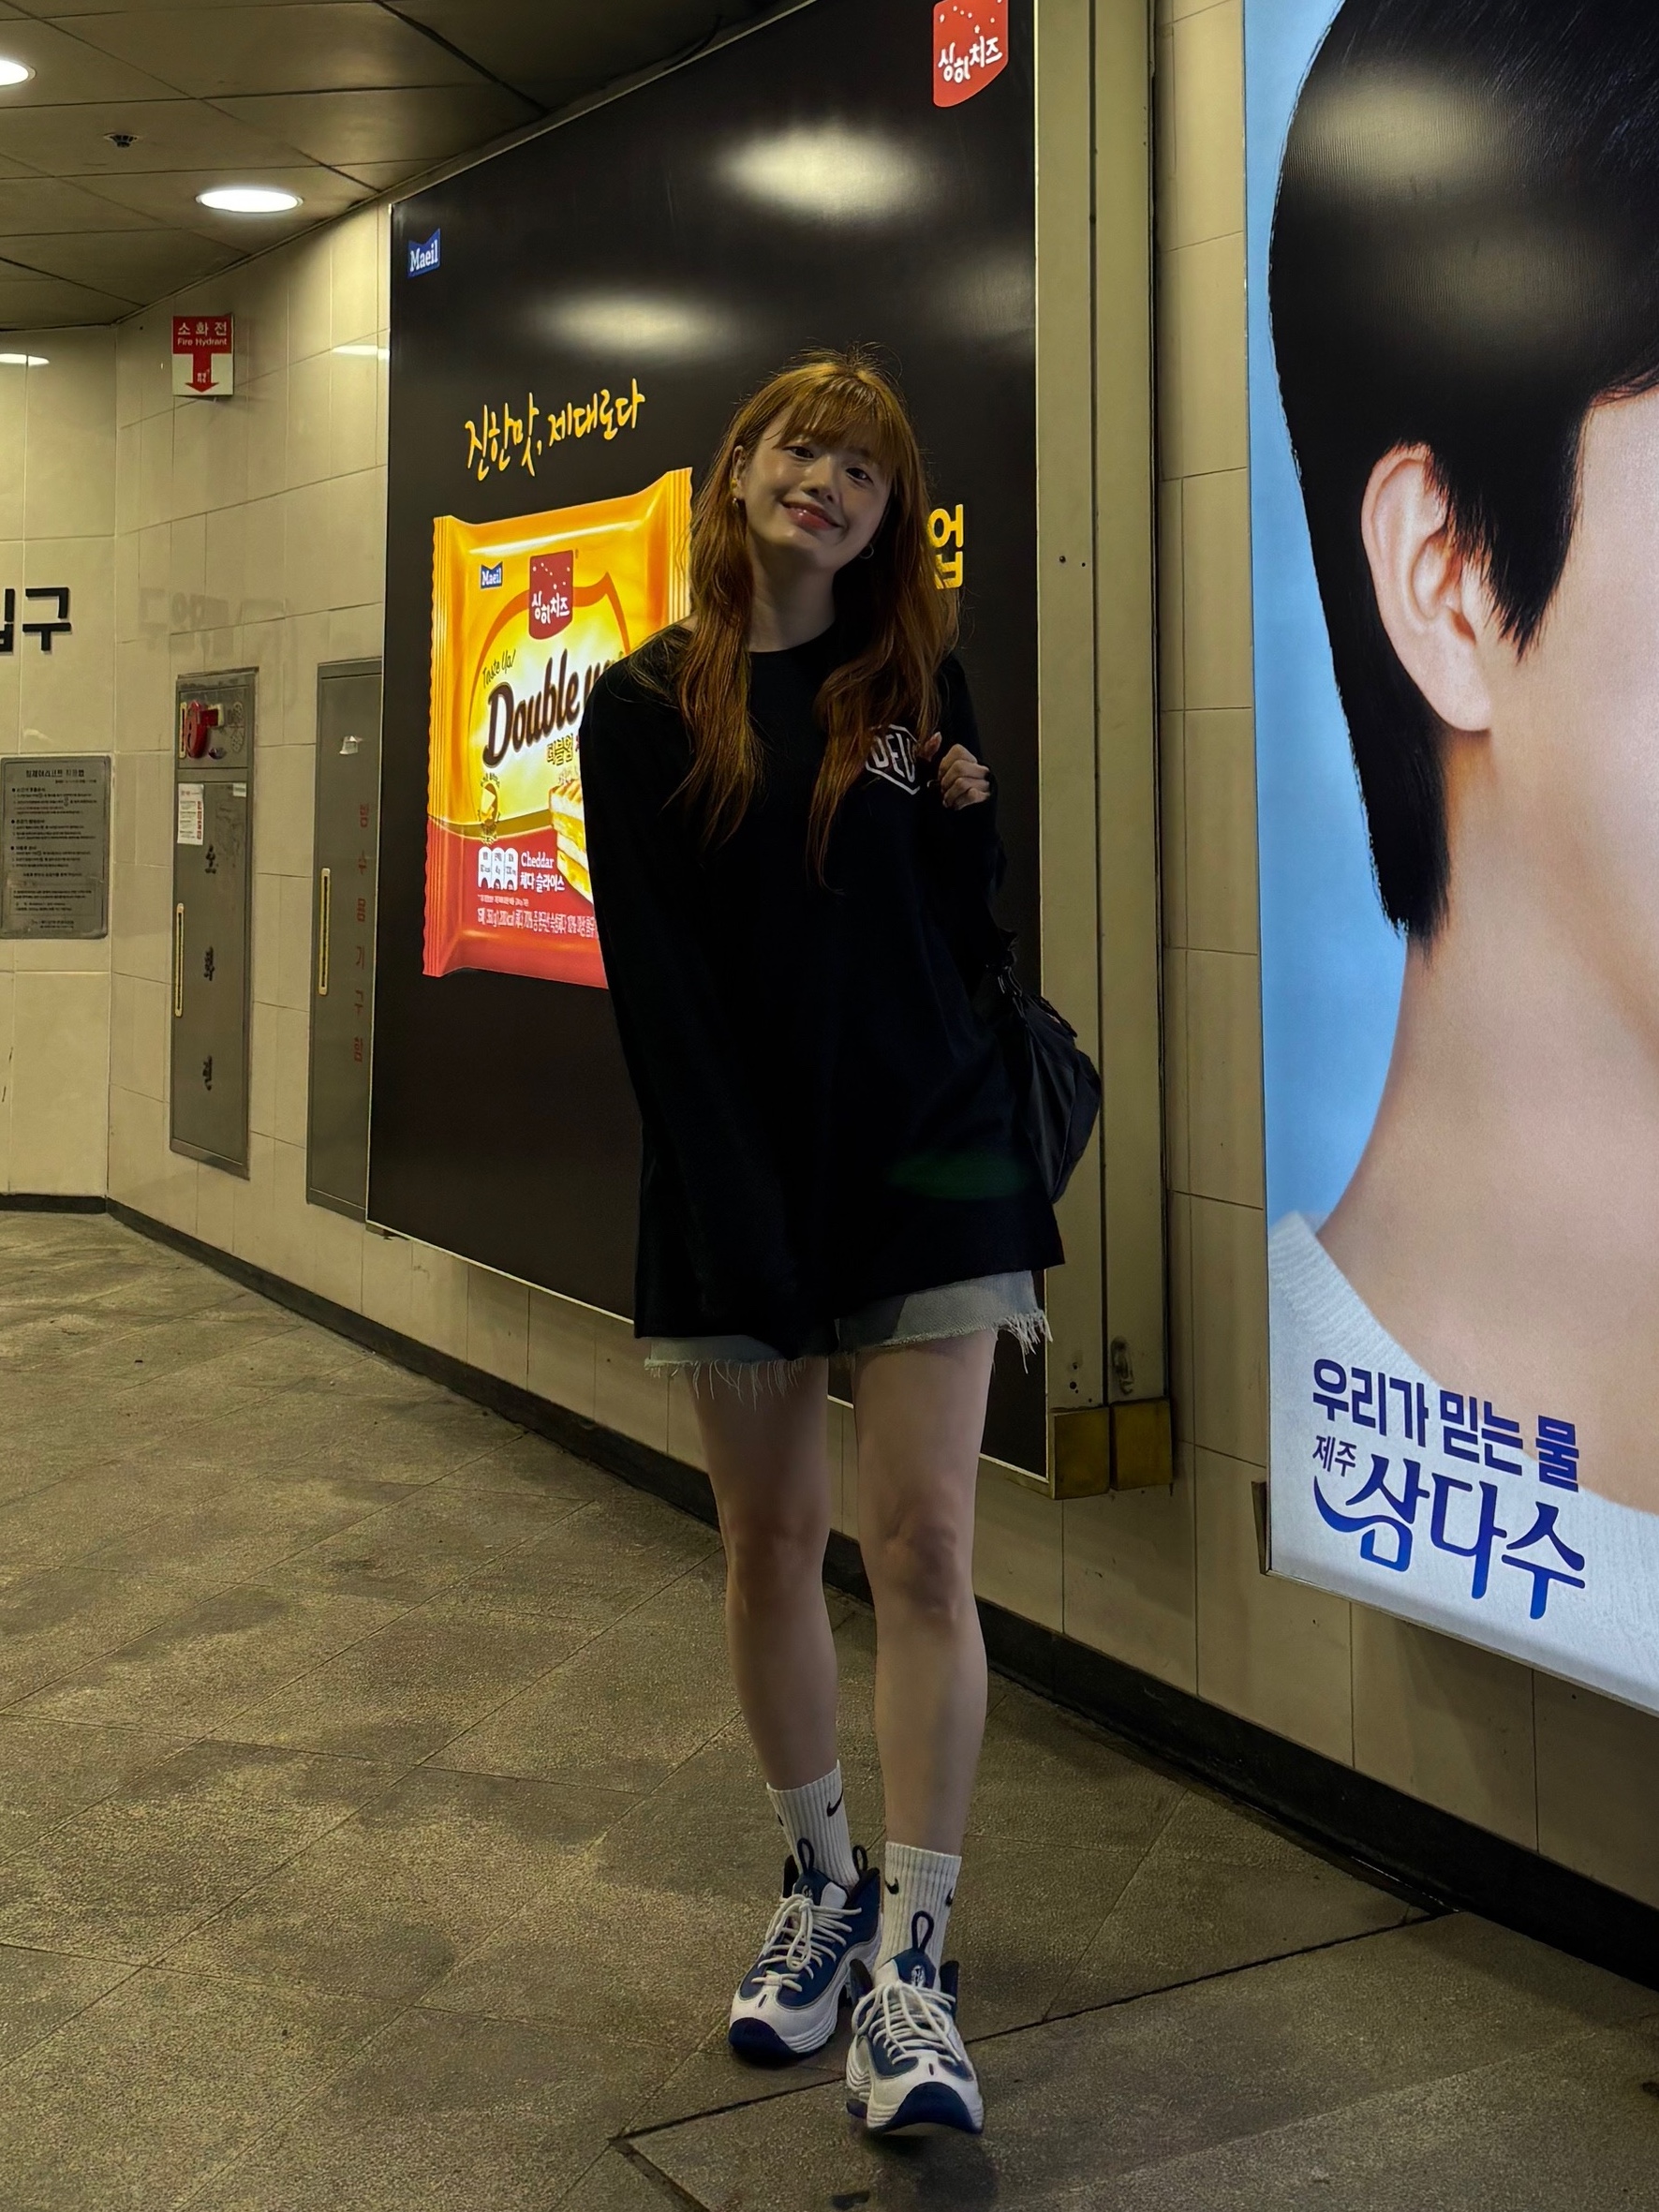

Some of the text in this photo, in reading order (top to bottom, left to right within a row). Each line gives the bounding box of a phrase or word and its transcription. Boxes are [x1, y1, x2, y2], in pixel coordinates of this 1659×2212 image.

[409, 239, 438, 272] Maeil
[196, 338, 227, 347] Hydrant
[548, 378, 645, 447] 제대로다
[481, 568, 502, 586] Maeil
[482, 647, 580, 768] Double
[521, 850, 555, 869] Cheddar
[536, 872, 566, 894] 슬라이스
[1313, 1358, 1580, 1492] 우리가 믿는 물
[1312, 1434, 1357, 1477] 제주
[1313, 1453, 1586, 1620] 삼다수
